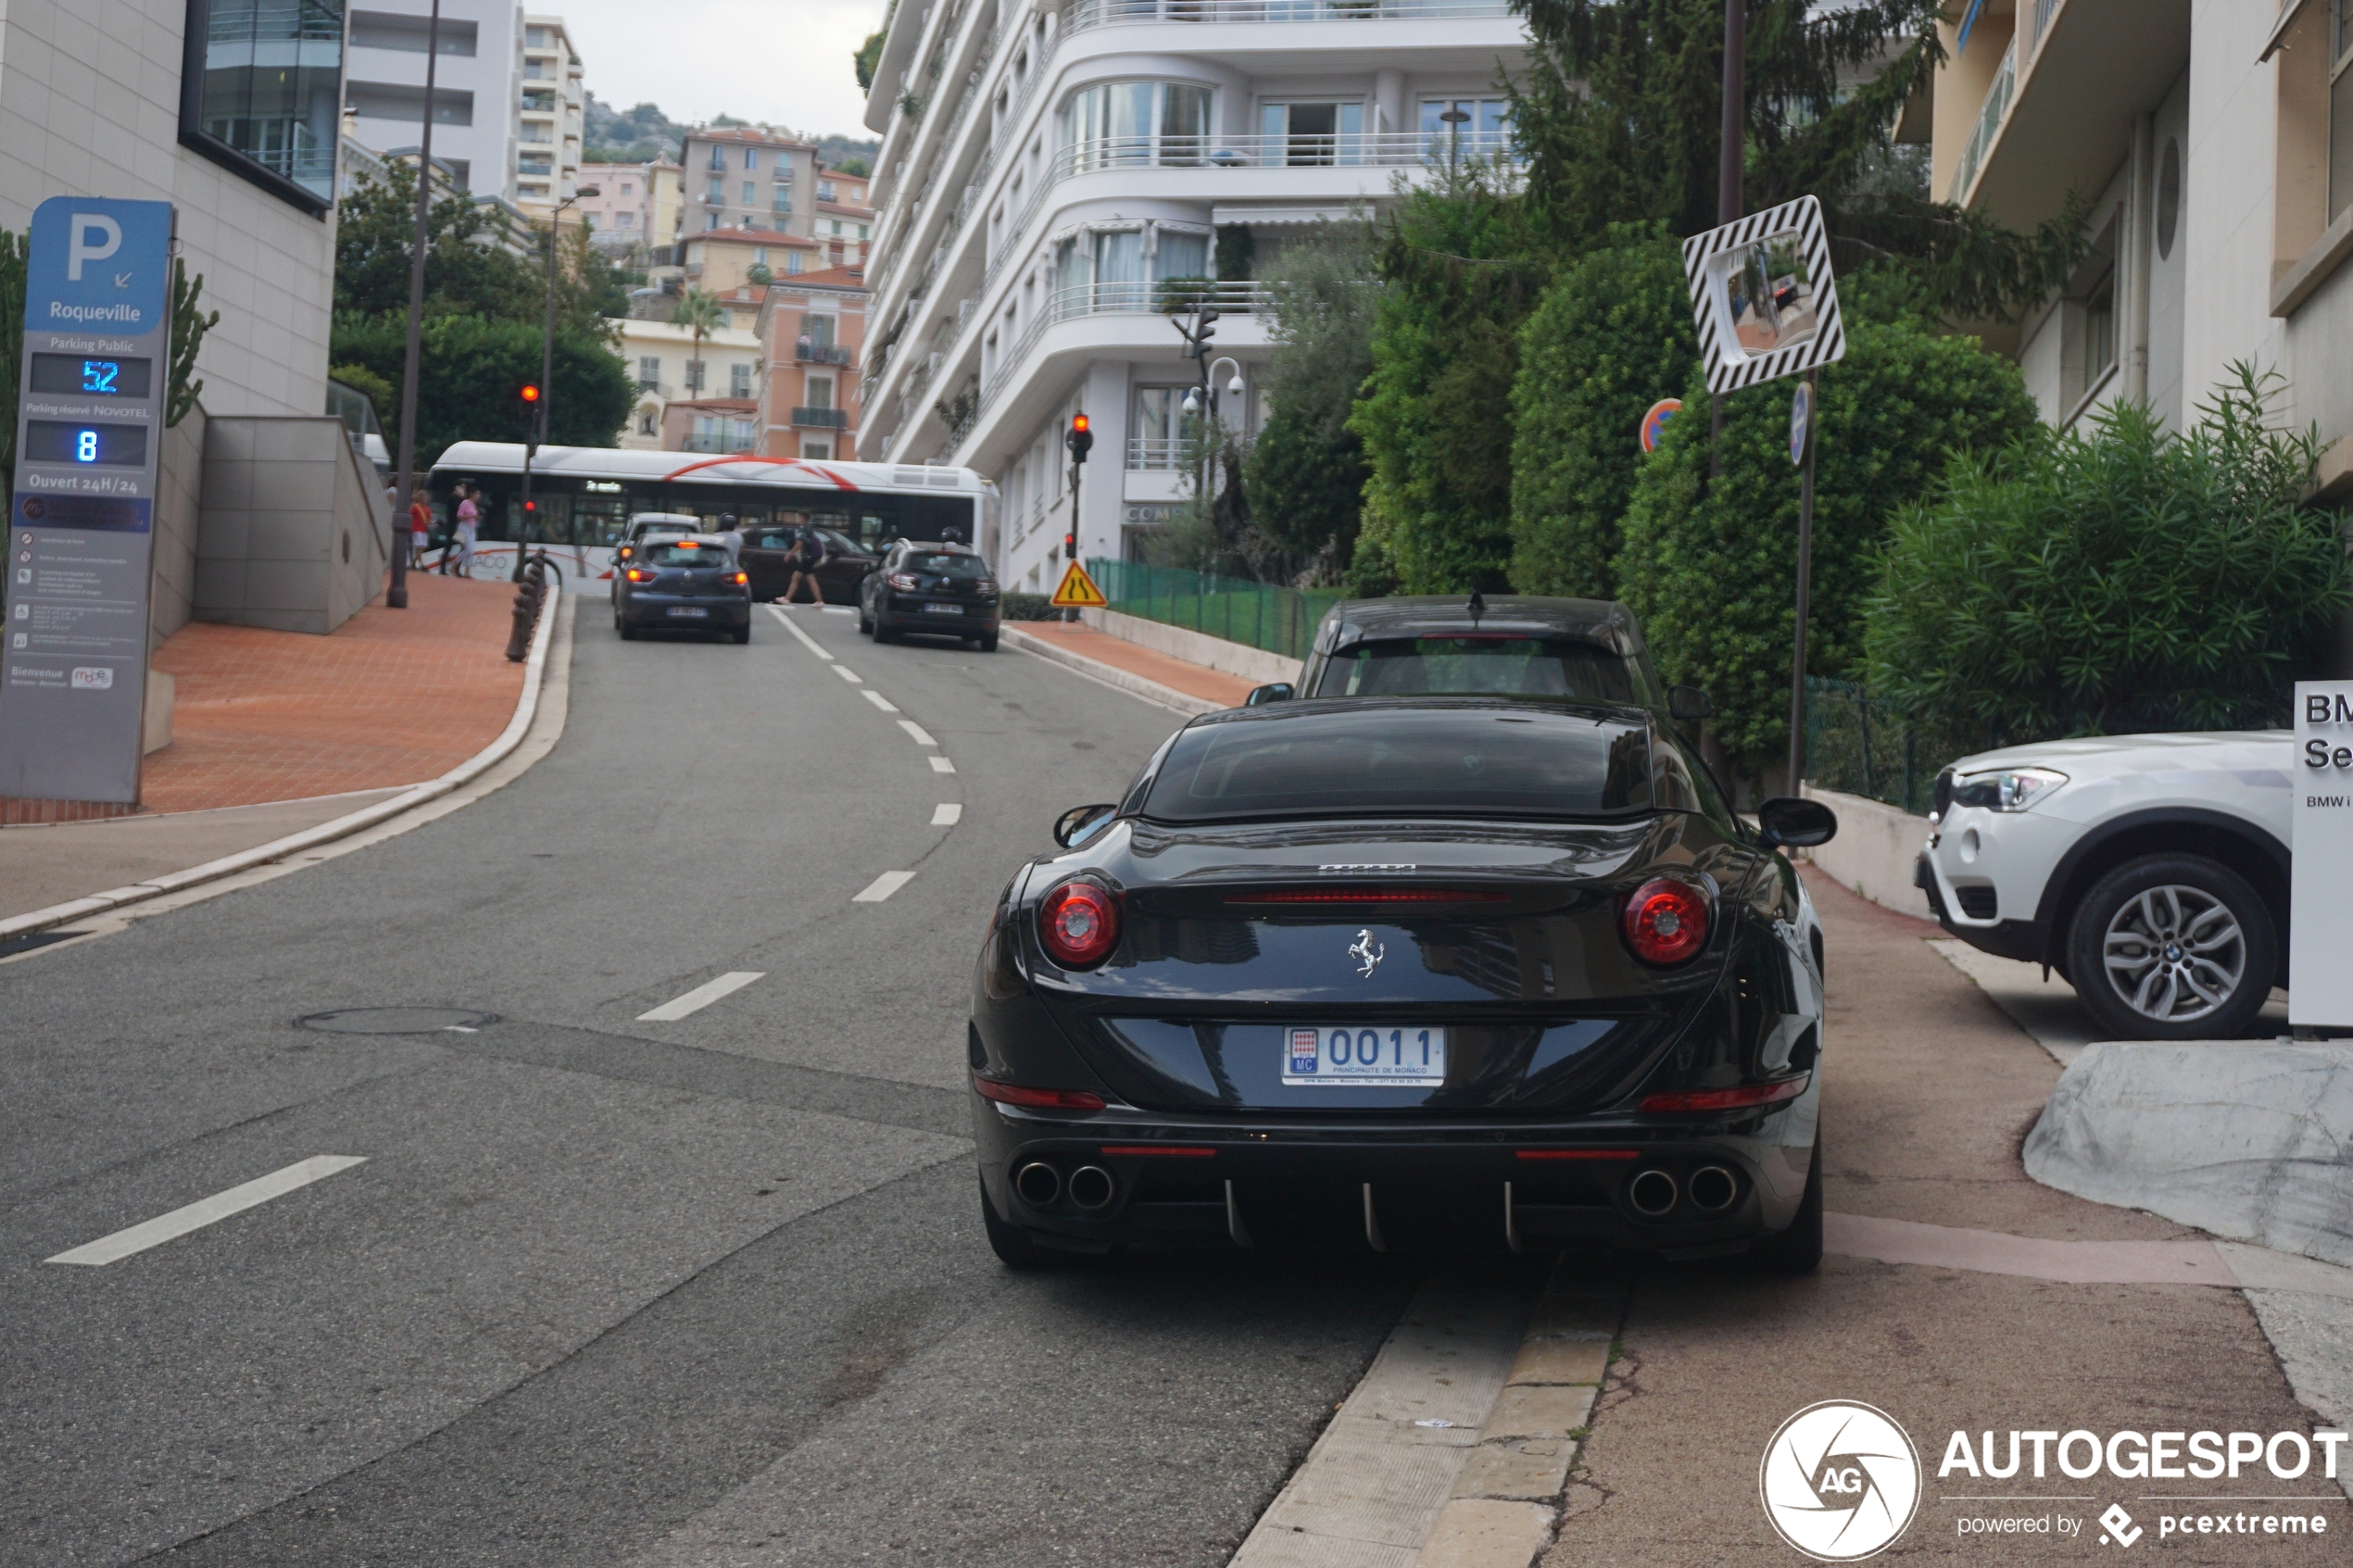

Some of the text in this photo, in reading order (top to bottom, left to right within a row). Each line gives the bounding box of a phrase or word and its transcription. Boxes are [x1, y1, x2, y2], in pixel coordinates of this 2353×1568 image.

[69, 212, 122, 282] P
[50, 301, 142, 322] Roqueville
[50, 337, 134, 353] Parking Public
[83, 360, 119, 393] 52
[26, 403, 151, 418] Parking réservé NOVOTEL
[79, 431, 98, 462] 8
[29, 473, 138, 495] Ouvert 24H/24
[11, 666, 64, 678] Bienvenue
[2304, 738, 2353, 769] Se
[2307, 796, 2350, 808] BMW i
[1329, 1029, 1429, 1065] 0011
[1297, 1059, 1313, 1070] MC
